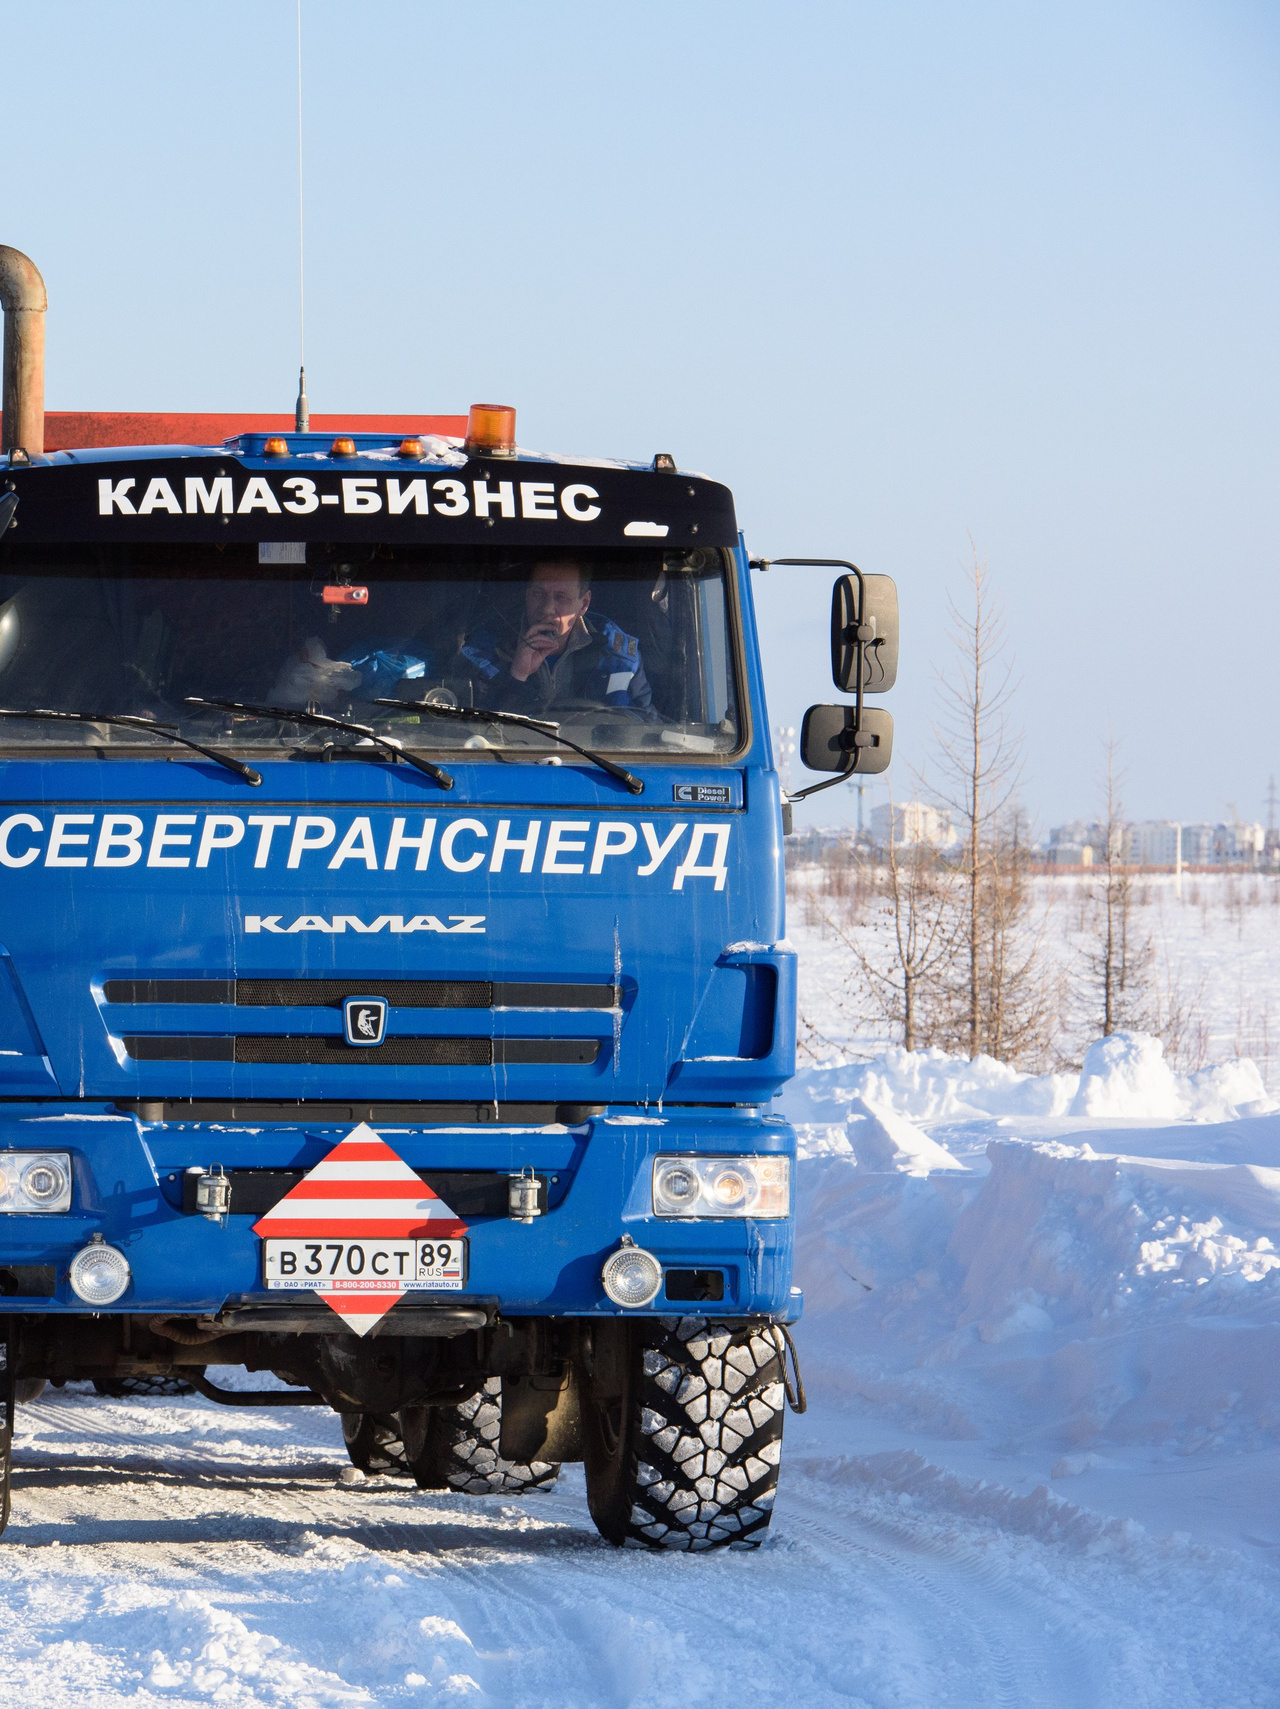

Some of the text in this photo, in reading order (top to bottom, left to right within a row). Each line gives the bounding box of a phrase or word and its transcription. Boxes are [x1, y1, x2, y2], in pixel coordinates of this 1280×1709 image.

[99, 477, 602, 523] КАМАЗ-БИЗНЕС
[697, 787, 726, 795] Diesel
[697, 793, 727, 802] Power
[243, 914, 487, 935] KAMAZ
[280, 1243, 452, 1275] В370СТ 89
[419, 1267, 442, 1277] RUS
[335, 1280, 397, 1289] 8-800-200-5330
